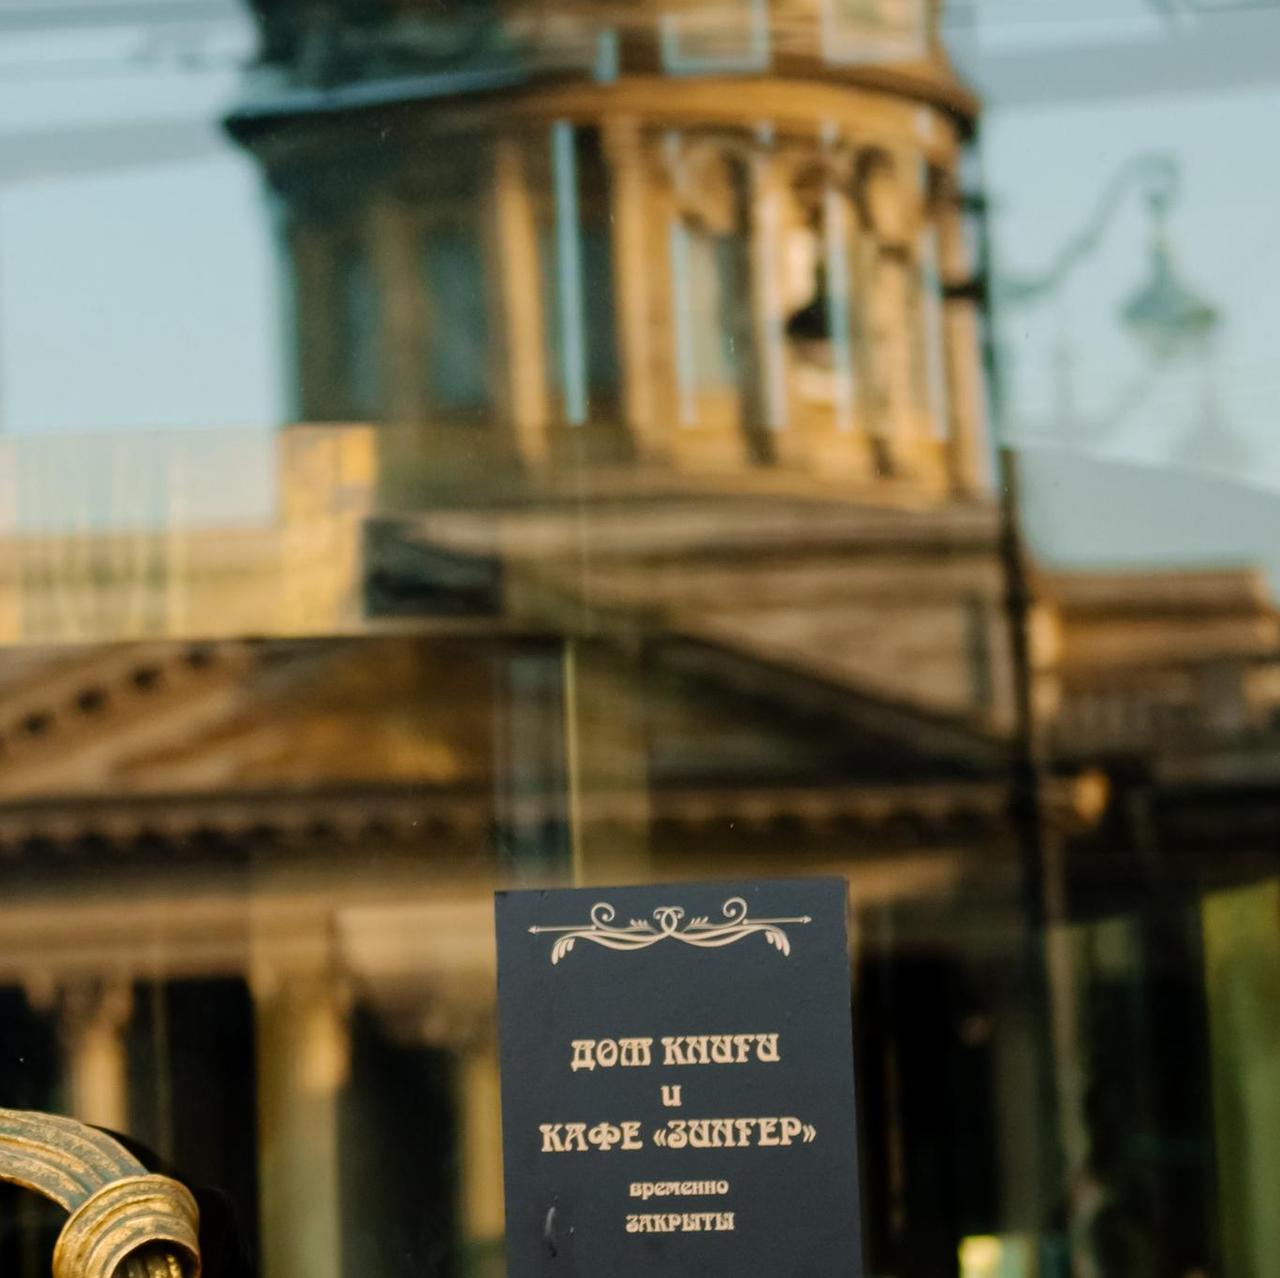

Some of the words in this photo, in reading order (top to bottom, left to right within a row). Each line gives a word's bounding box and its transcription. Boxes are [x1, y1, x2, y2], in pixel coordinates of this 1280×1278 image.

[570, 1037, 653, 1072] ДОМ
[661, 1033, 781, 1066] КНИГИ
[539, 1121, 643, 1152] КАФЕ
[652, 1116, 817, 1149] «ЗИНГЕР»
[629, 1179, 729, 1200] временно
[625, 1212, 735, 1233] ЗАКРЫТЫ
